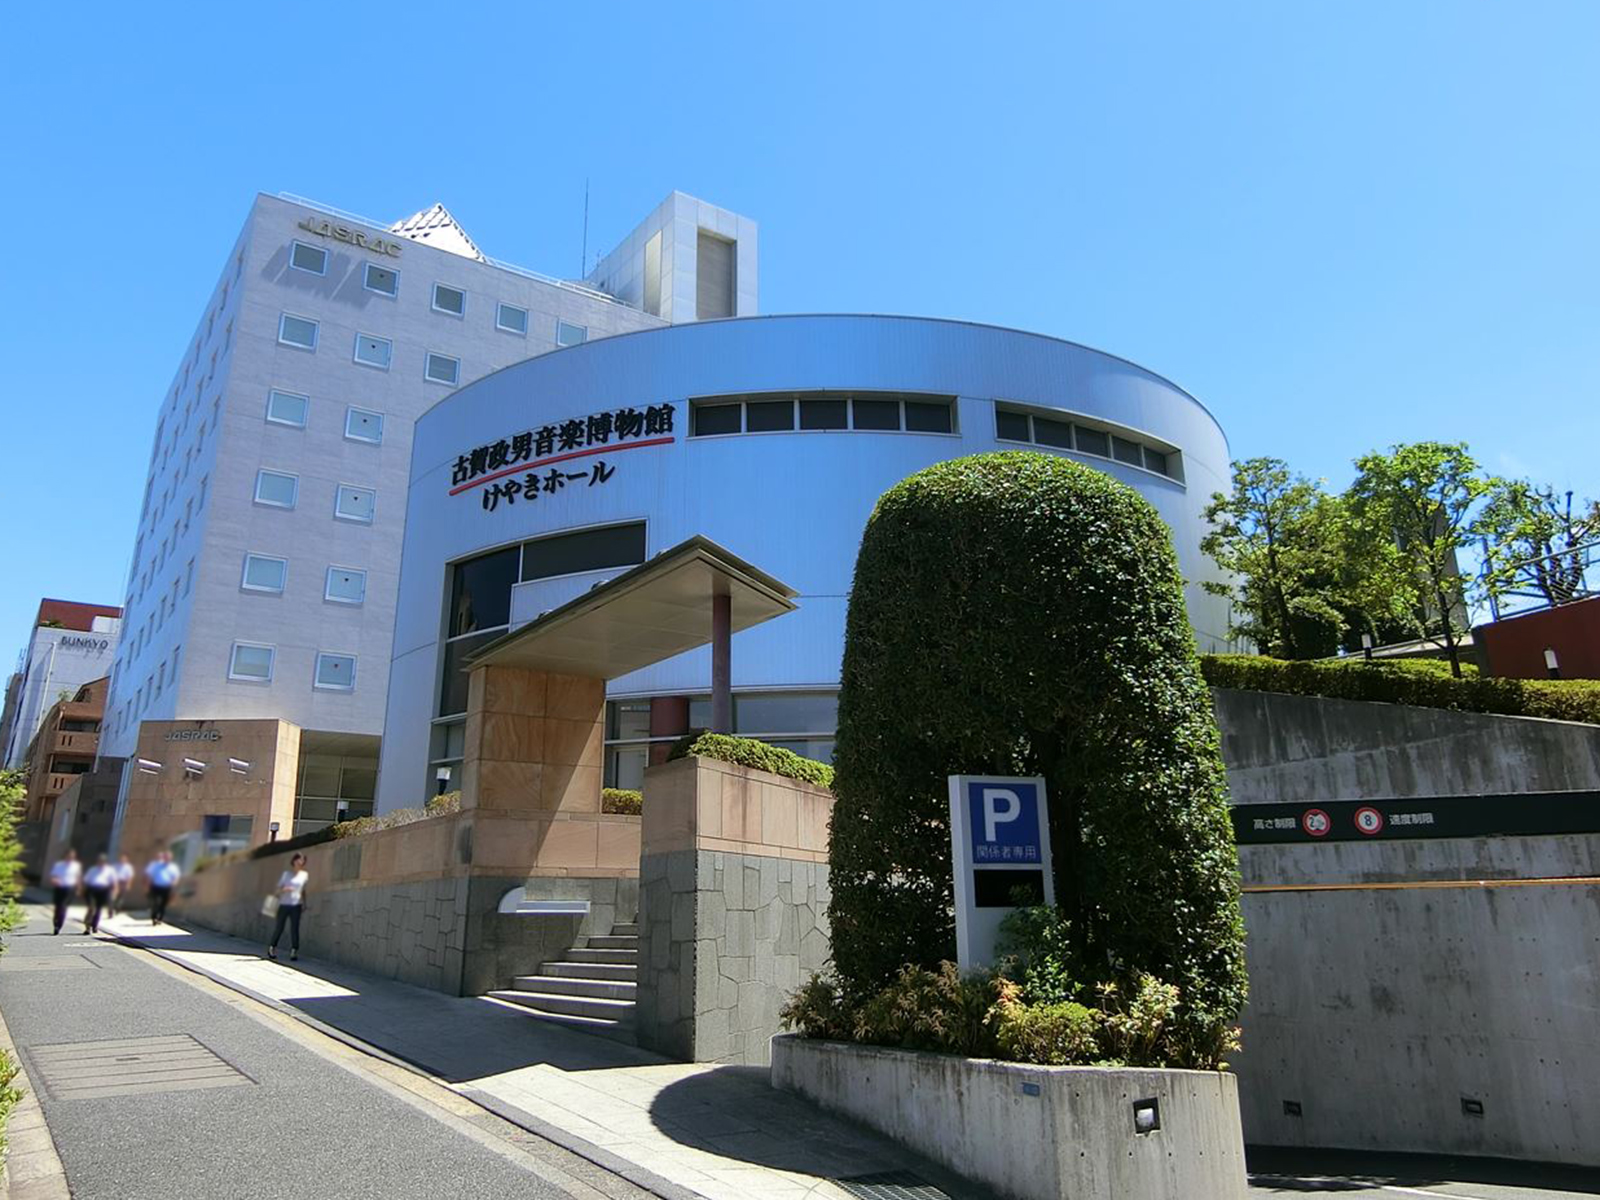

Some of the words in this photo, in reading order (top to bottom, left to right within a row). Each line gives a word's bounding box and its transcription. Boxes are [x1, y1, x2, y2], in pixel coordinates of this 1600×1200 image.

[298, 216, 402, 258] JASRAC
[452, 403, 675, 485] 古賀政男音楽博物館
[482, 461, 616, 512] けやきホール
[61, 636, 108, 650] BUNKYO
[164, 730, 218, 741] JASRAC
[983, 788, 1020, 842] P
[1364, 814, 1373, 827] 8
[1389, 813, 1434, 826] 速度制限
[1253, 817, 1296, 830] 高さ制限
